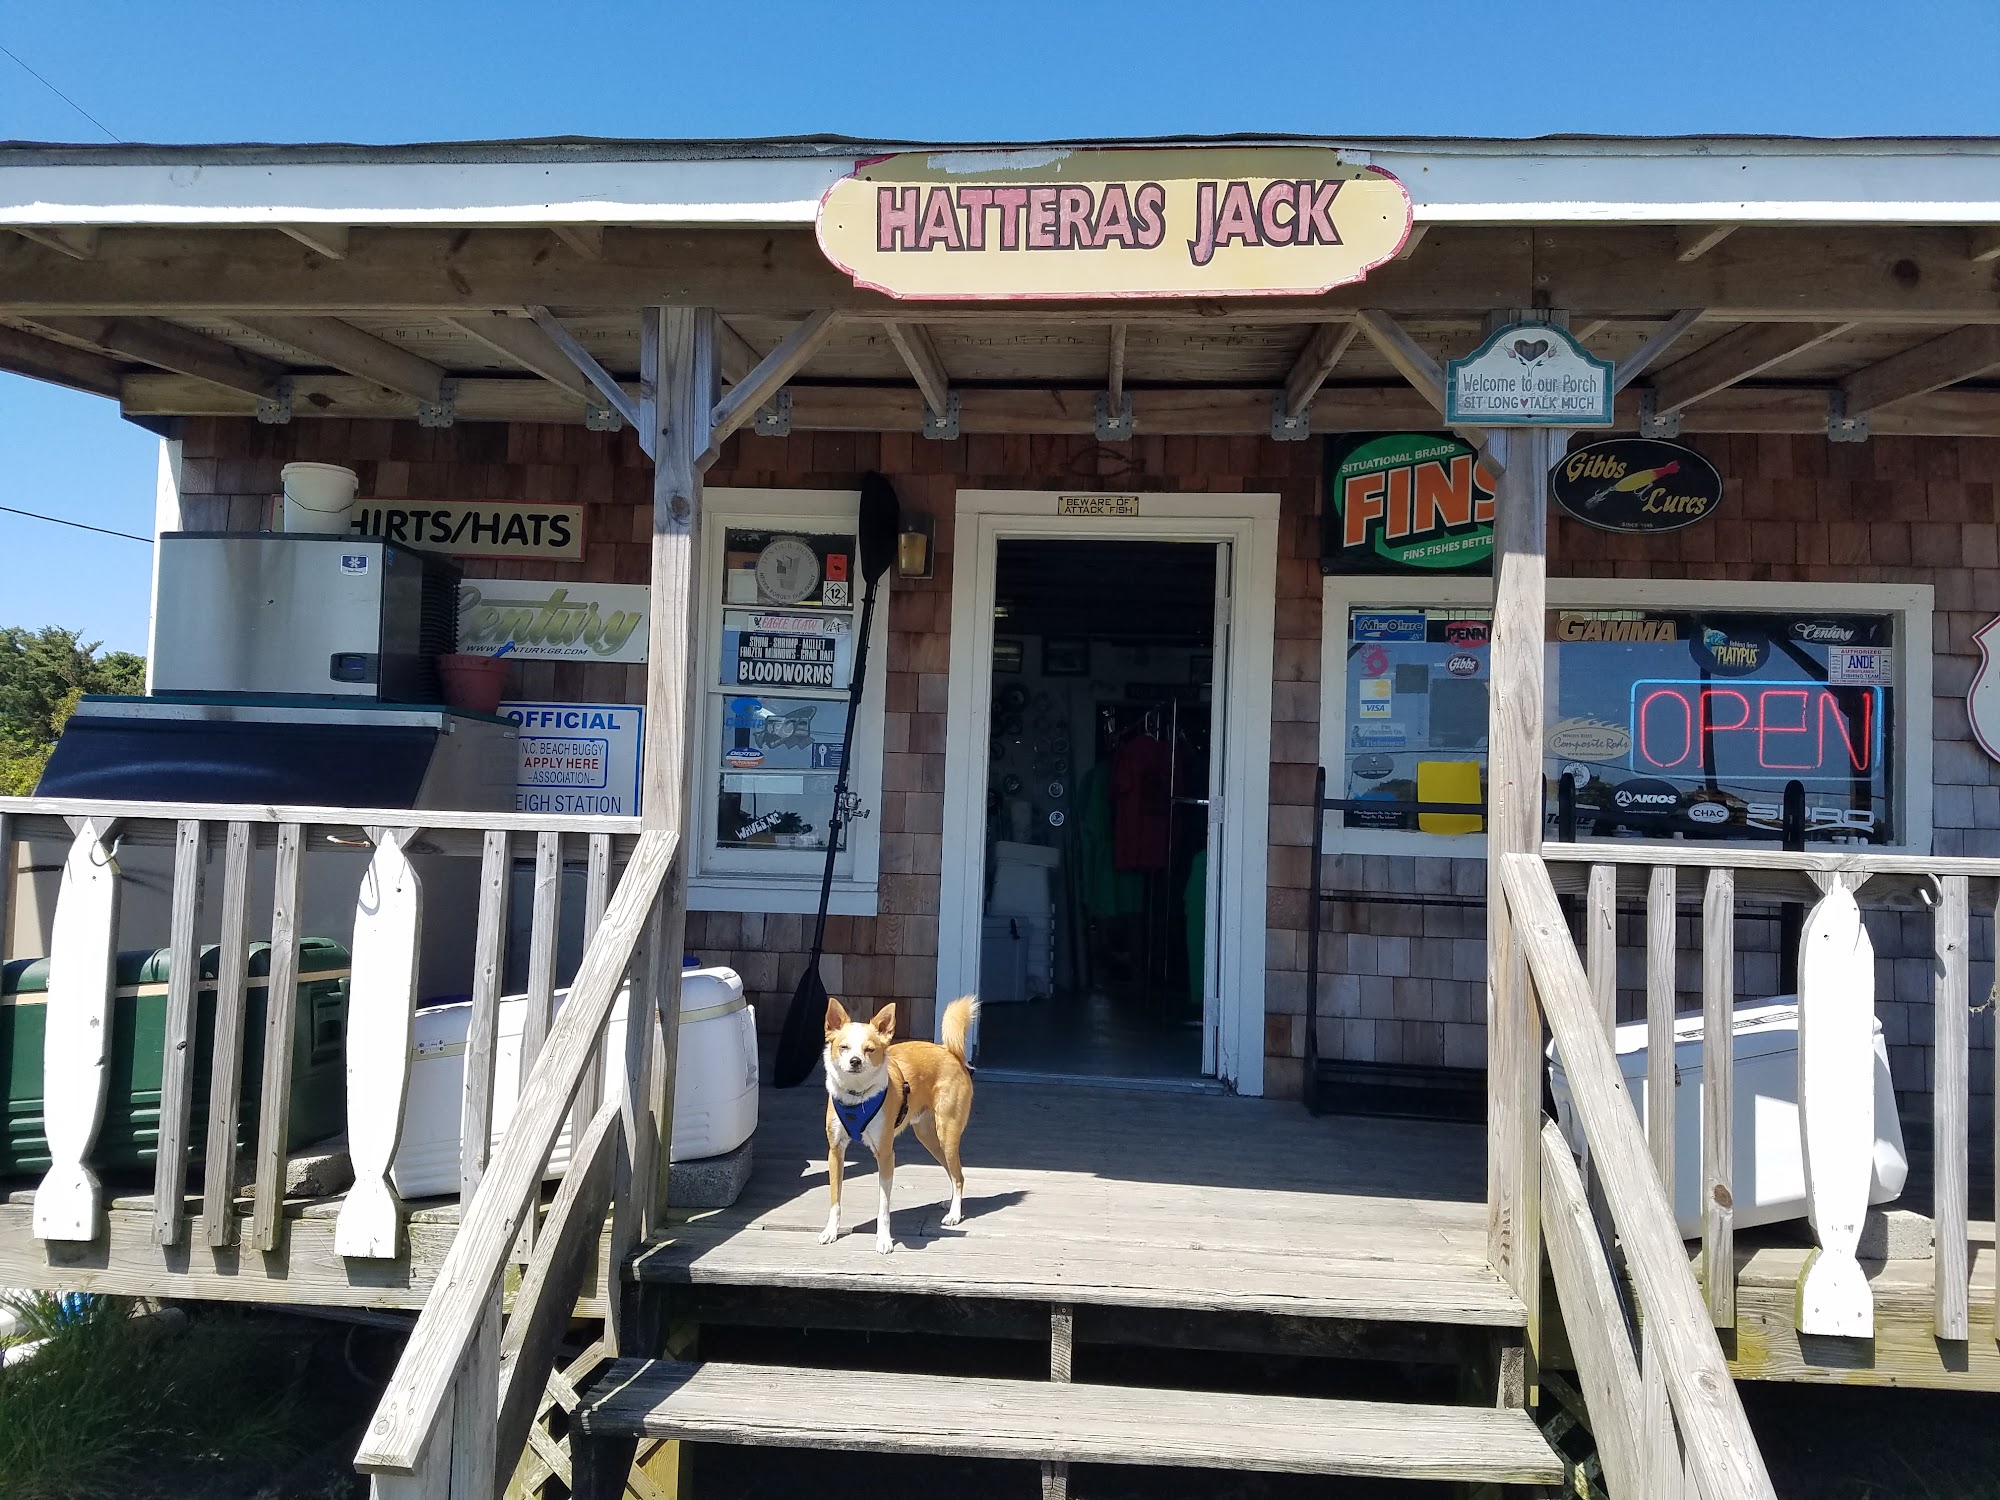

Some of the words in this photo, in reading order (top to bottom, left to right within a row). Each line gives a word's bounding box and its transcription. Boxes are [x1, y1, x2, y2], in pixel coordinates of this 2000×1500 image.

[876, 184, 1166, 252] HATTERAS
[1186, 179, 1346, 266] JACK
[1463, 374, 1515, 392] Welcome
[1521, 375, 1532, 392] to
[1538, 379, 1556, 393] our
[1563, 374, 1597, 393] Porch
[1464, 397, 1483, 409] SIT
[1488, 397, 1518, 409] LONG
[1530, 397, 1556, 409] TALK
[1561, 397, 1594, 409] MUCH
[1341, 453, 1412, 473] SITUATIONAL
[1415, 444, 1455, 460] BRAIDS
[1567, 452, 1627, 482] Gibbs
[1642, 487, 1707, 514] Lures
[351, 508, 571, 547] HIRTS/HATS
[1403, 548, 1425, 560] FINS
[1427, 541, 1460, 556] FISHES
[1462, 535, 1494, 549] BETTE
[830, 589, 841, 599] 12
[1447, 627, 1487, 641] PENN
[1556, 613, 1677, 642] GAMMA
[1795, 623, 1854, 642] Century
[466, 645, 588, 656] WWW.CNTURY.GB.COM
[749, 636, 768, 648] SQUID
[773, 637, 798, 649] SHRIMP
[802, 639, 826, 650] MULLET
[740, 647, 762, 658] FROZEN
[820, 650, 834, 662] BAIT
[1718, 646, 1757, 664] PLATYPUS
[1847, 655, 1875, 669] ANDE
[739, 661, 833, 684] BLOODWORMS
[1448, 657, 1477, 672] Gibbs
[507, 710, 621, 729] OFFICIAL
[1640, 690, 1871, 771] OPEN
[521, 743, 537, 754] N.C.
[540, 743, 570, 755] BEACH
[573, 744, 604, 756] BUGGY
[1553, 737, 1605, 752] Composite
[1606, 737, 1629, 750] Rods
[524, 757, 563, 768] APPLY
[566, 758, 599, 769] HERE
[515, 794, 550, 812] EIGH
[555, 795, 621, 813] STATION
[1632, 794, 1677, 804] AKIOS
[1693, 809, 1724, 818] CHAC
[1747, 803, 1874, 827] SRO
